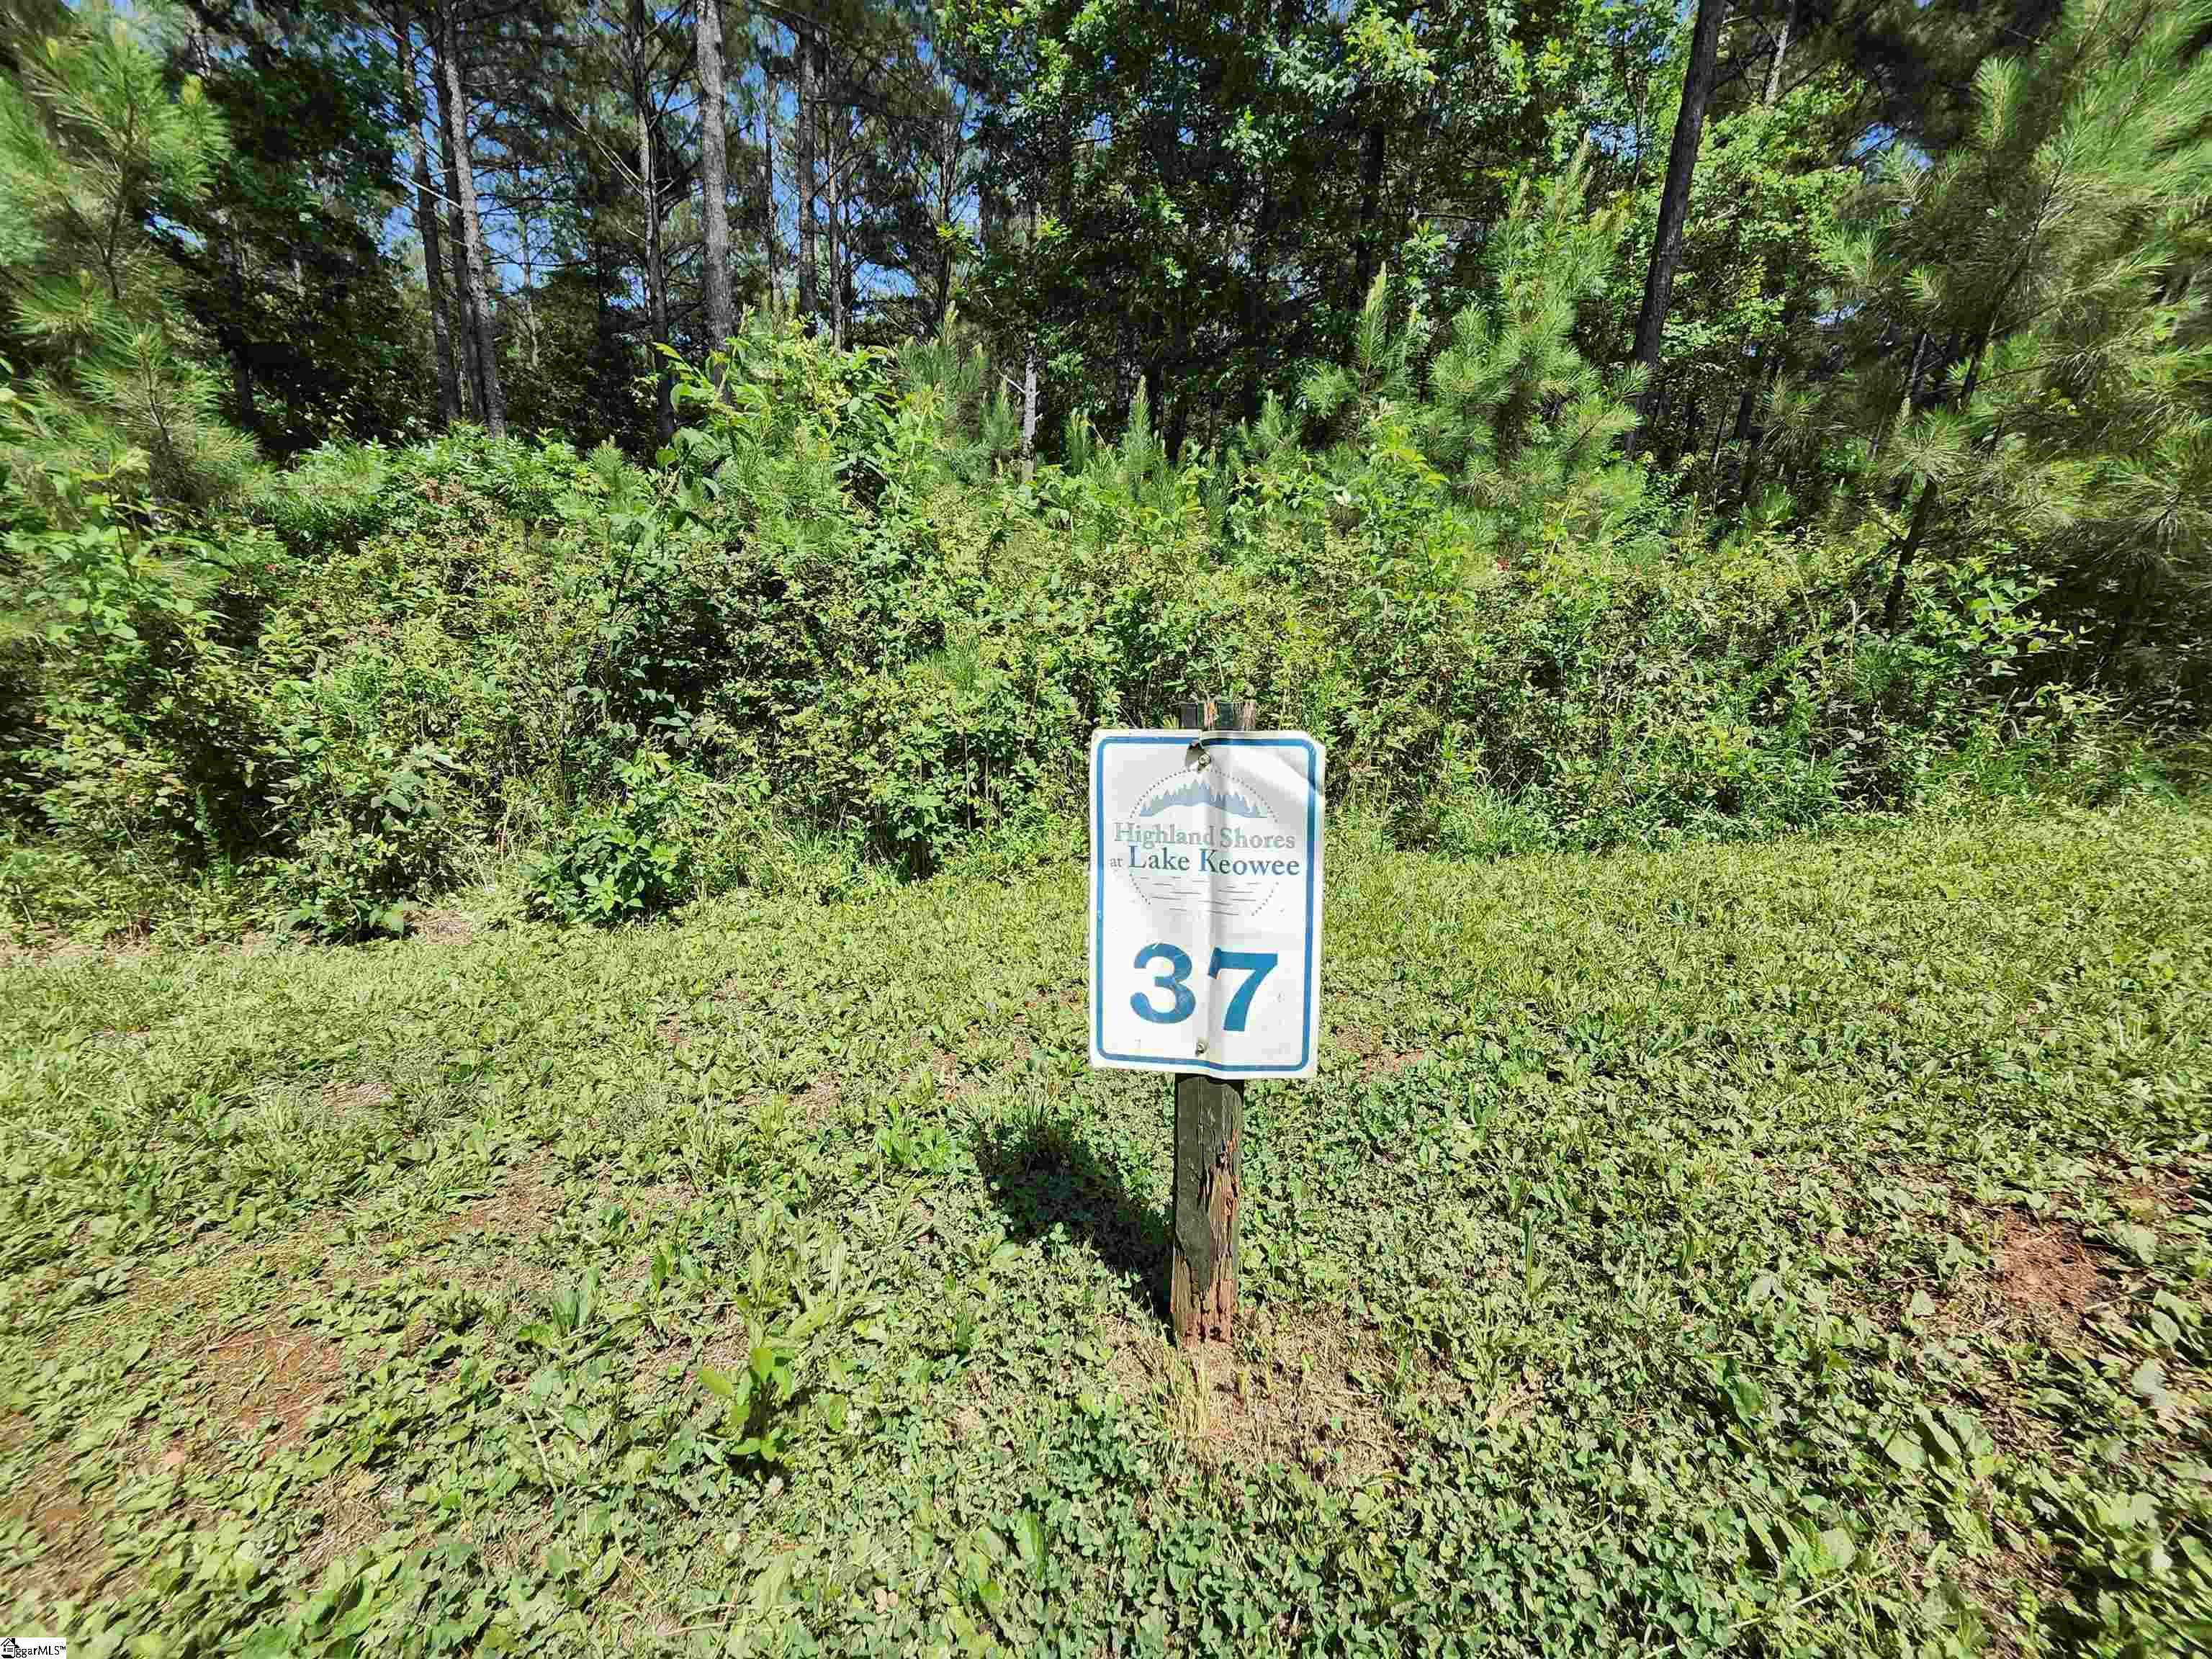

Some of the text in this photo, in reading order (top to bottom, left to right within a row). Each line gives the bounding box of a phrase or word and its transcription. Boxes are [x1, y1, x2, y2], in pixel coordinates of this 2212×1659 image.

[1113, 822, 1297, 850] Highland Shores
[1110, 845, 1300, 876] at Lake Keowee
[1130, 942, 1279, 1033] 37
